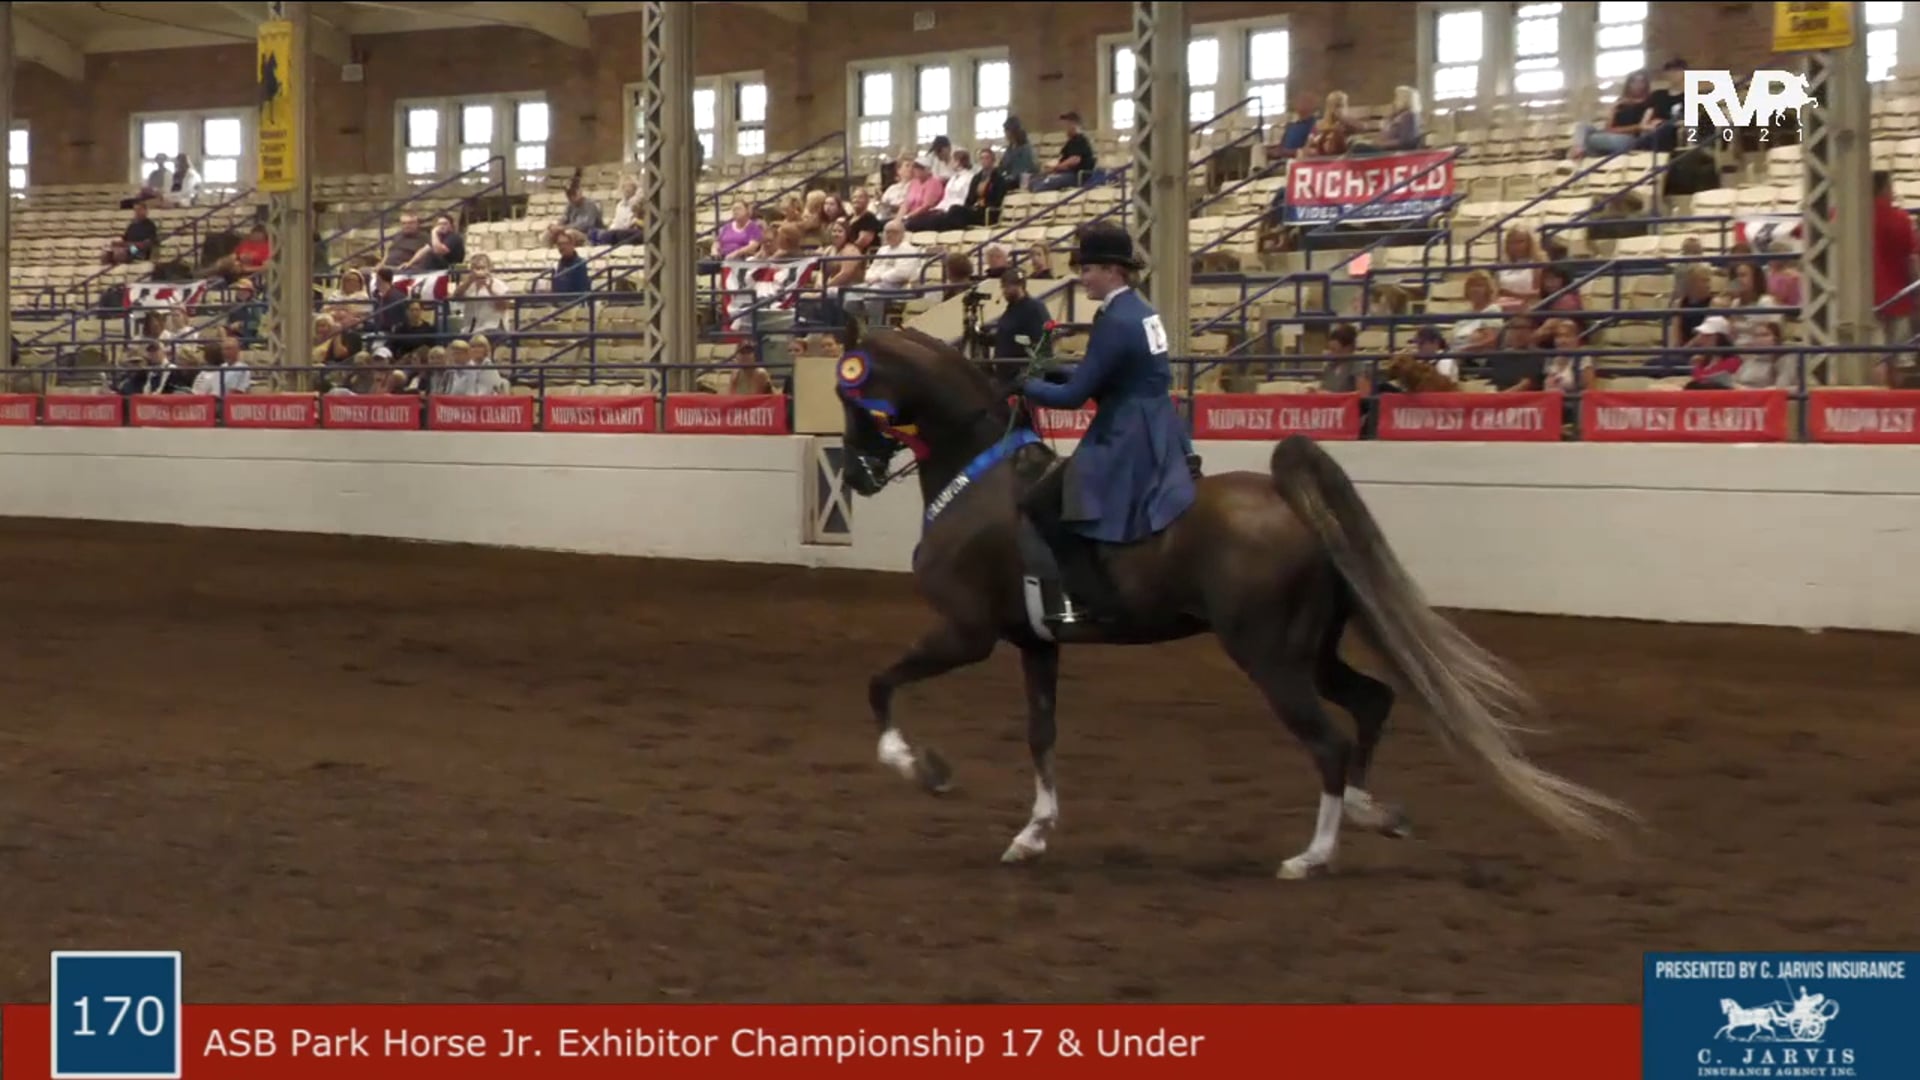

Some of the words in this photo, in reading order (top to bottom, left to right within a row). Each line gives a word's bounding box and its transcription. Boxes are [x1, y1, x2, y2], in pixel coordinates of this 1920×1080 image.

[1293, 162, 1447, 200] RICHFIELD
[1296, 206, 1339, 219] VIDEO
[435, 405, 476, 425] MIDWEST
[480, 405, 524, 425] CHARITY
[551, 405, 597, 426] MIDWEST
[600, 405, 645, 426] CHARITY
[673, 407, 724, 428] MIDWEST
[726, 407, 776, 428] CHARITY
[1038, 408, 1096, 430] MIDWES
[1206, 407, 1274, 431] MIDWEST
[1279, 407, 1346, 431] CHARITY
[1391, 407, 1464, 431] MIDWEST
[1470, 407, 1545, 431] CHARITY
[1595, 407, 1677, 432] MIDWEST
[1683, 407, 1767, 432] CHARITY
[1823, 408, 1917, 433] MIDWEST
